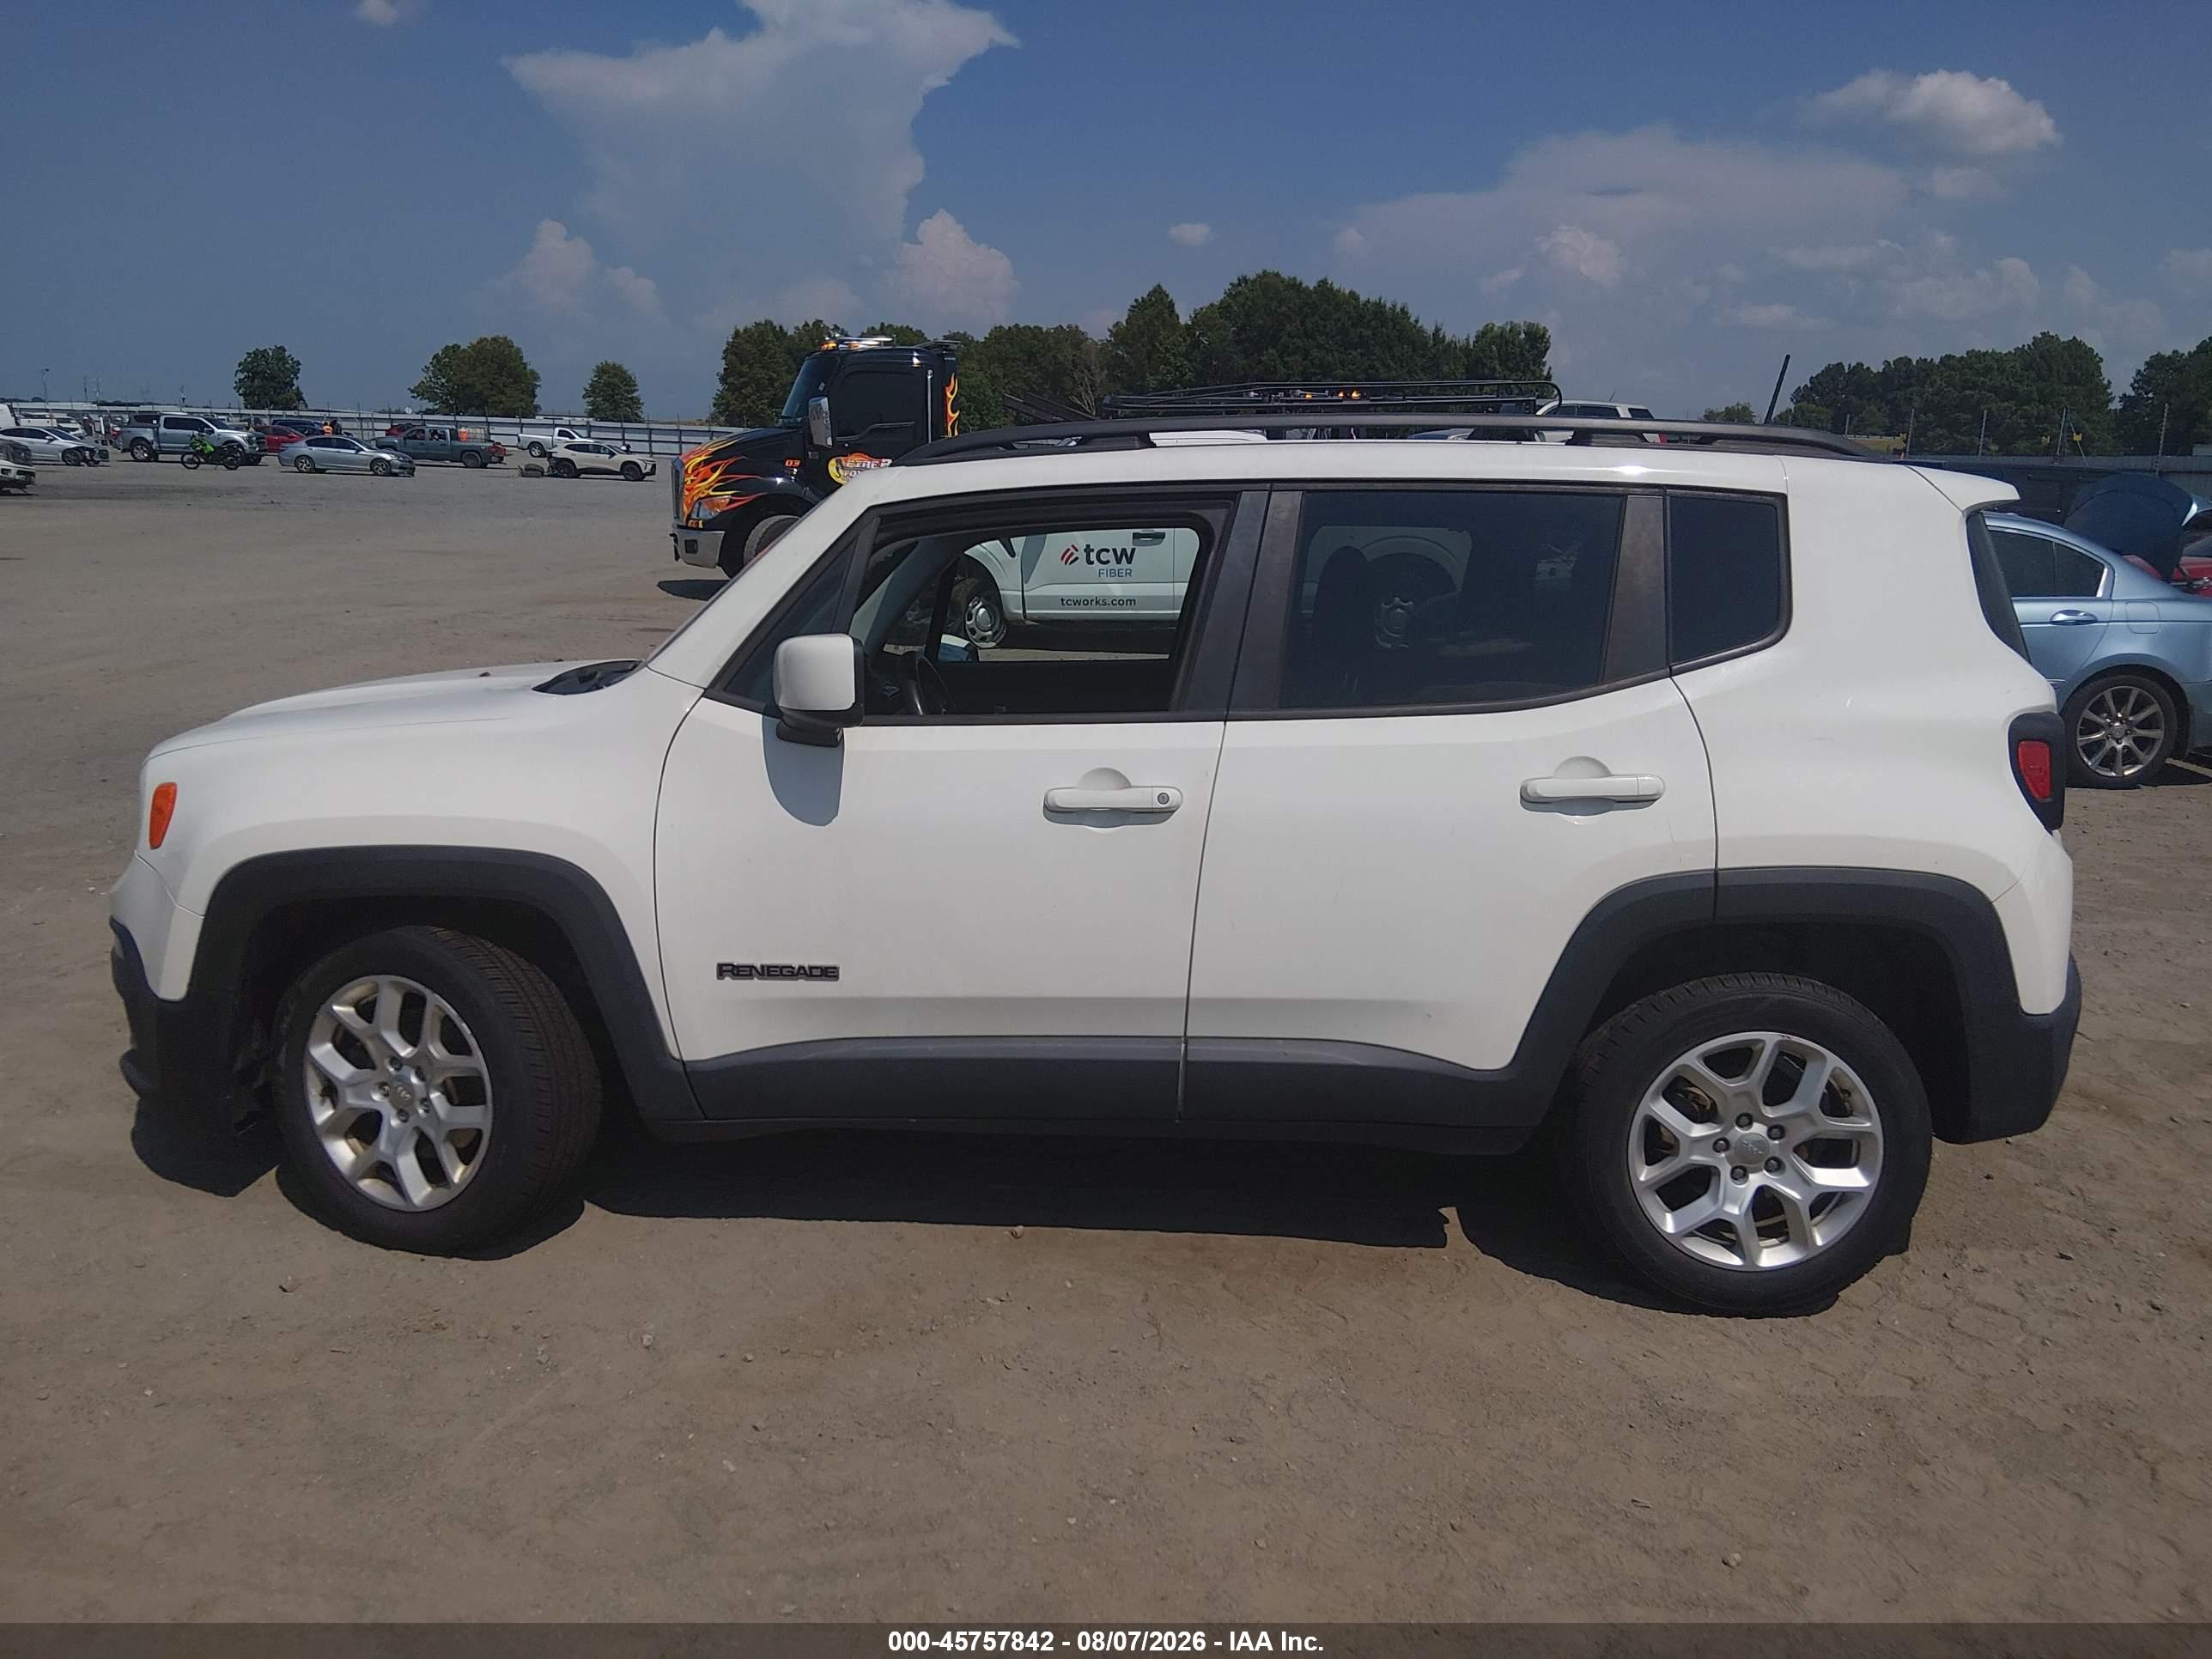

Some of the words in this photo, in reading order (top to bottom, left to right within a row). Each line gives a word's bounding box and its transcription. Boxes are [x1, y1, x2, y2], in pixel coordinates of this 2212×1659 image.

[1084, 544, 1136, 565] tcw
[1098, 568, 1133, 578] FIBER
[1060, 596, 1136, 606] tcworks.com
[717, 963, 839, 981] RENEGADE
